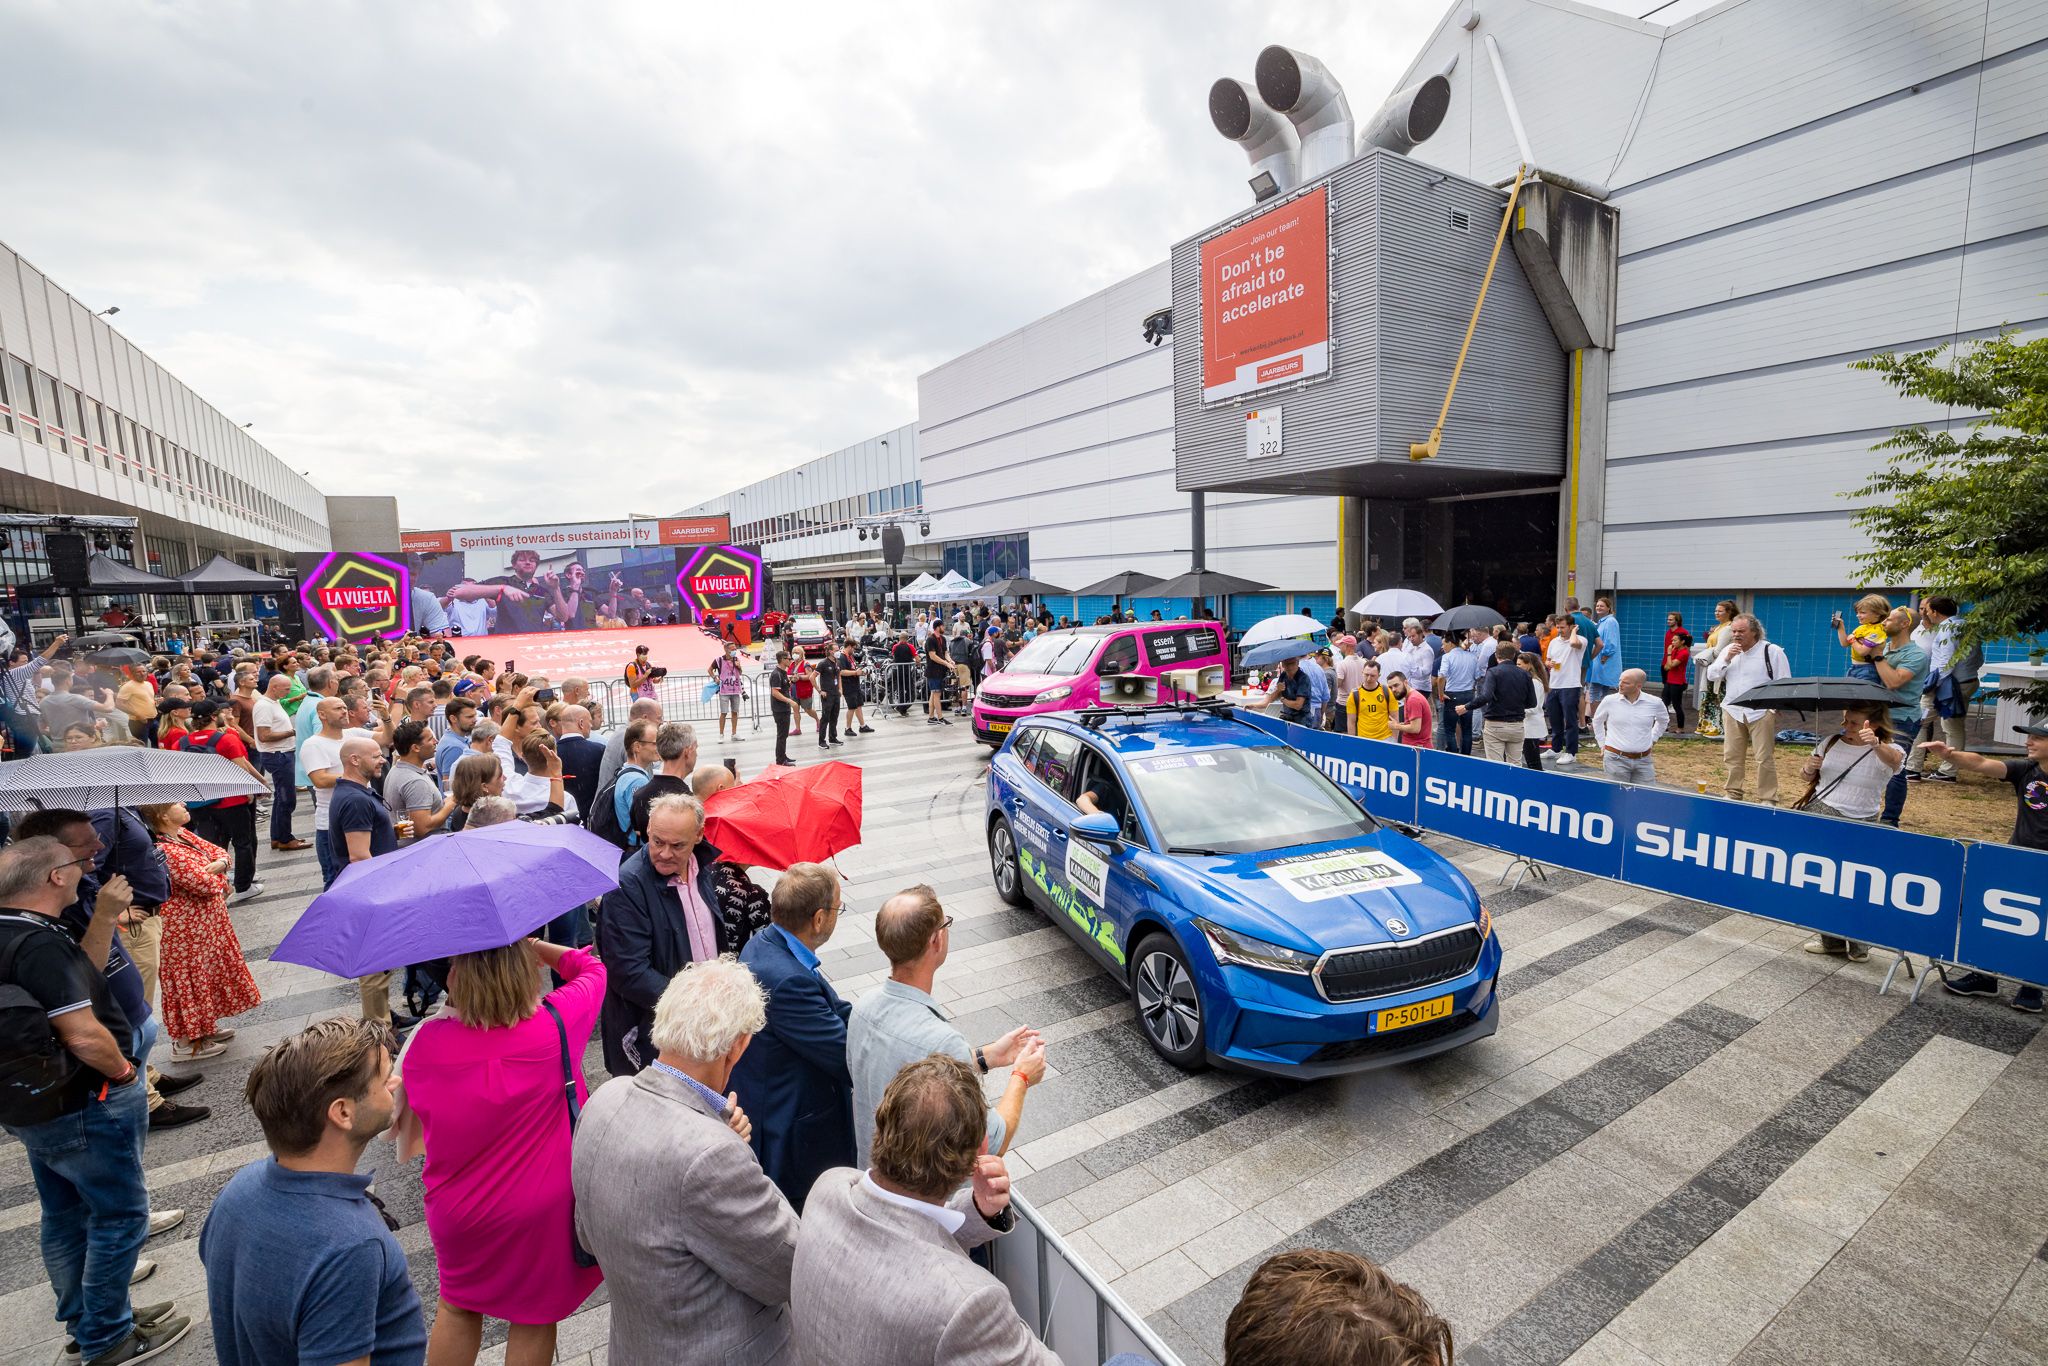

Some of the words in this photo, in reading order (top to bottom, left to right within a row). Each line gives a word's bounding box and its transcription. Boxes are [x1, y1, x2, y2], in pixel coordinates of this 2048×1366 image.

[1250, 234, 1265, 245] Join
[1266, 227, 1278, 238] our
[1279, 216, 1299, 233] team!
[1221, 251, 1261, 282] Don't
[1265, 245, 1285, 264] be
[1221, 270, 1265, 303] afraid
[1268, 267, 1286, 284] to
[1222, 282, 1304, 324] accelerate
[1260, 361, 1299, 377] JAARBEURS
[1266, 425, 1271, 435] 1
[1259, 440, 1278, 456] 322
[460, 535, 514, 549] Sprinting
[516, 531, 565, 544] towards
[567, 527, 651, 543] sustainabiity
[671, 526, 716, 535] JAARBEURS
[695, 579, 708, 592] LA
[709, 577, 747, 591] VUELTA
[325, 591, 343, 606] LA
[343, 589, 392, 605] VUELTA
[1153, 635, 1175, 647] essent
[1367, 704, 1377, 713] 10
[1151, 756, 1185, 766] SERVICIO
[1154, 762, 1189, 771] CARRERA
[1425, 776, 1614, 845] SHIMANO
[1275, 857, 1288, 865] LA
[1288, 853, 1315, 864] VUELTA
[1314, 848, 1347, 860] HOLANDA
[1286, 864, 1311, 877] DE
[1311, 855, 1376, 873] GROENE
[1635, 821, 1942, 916] SHIMANO
[1299, 865, 1392, 890] KARAVAAN
[1385, 1000, 1446, 1028] P-501-LJ
